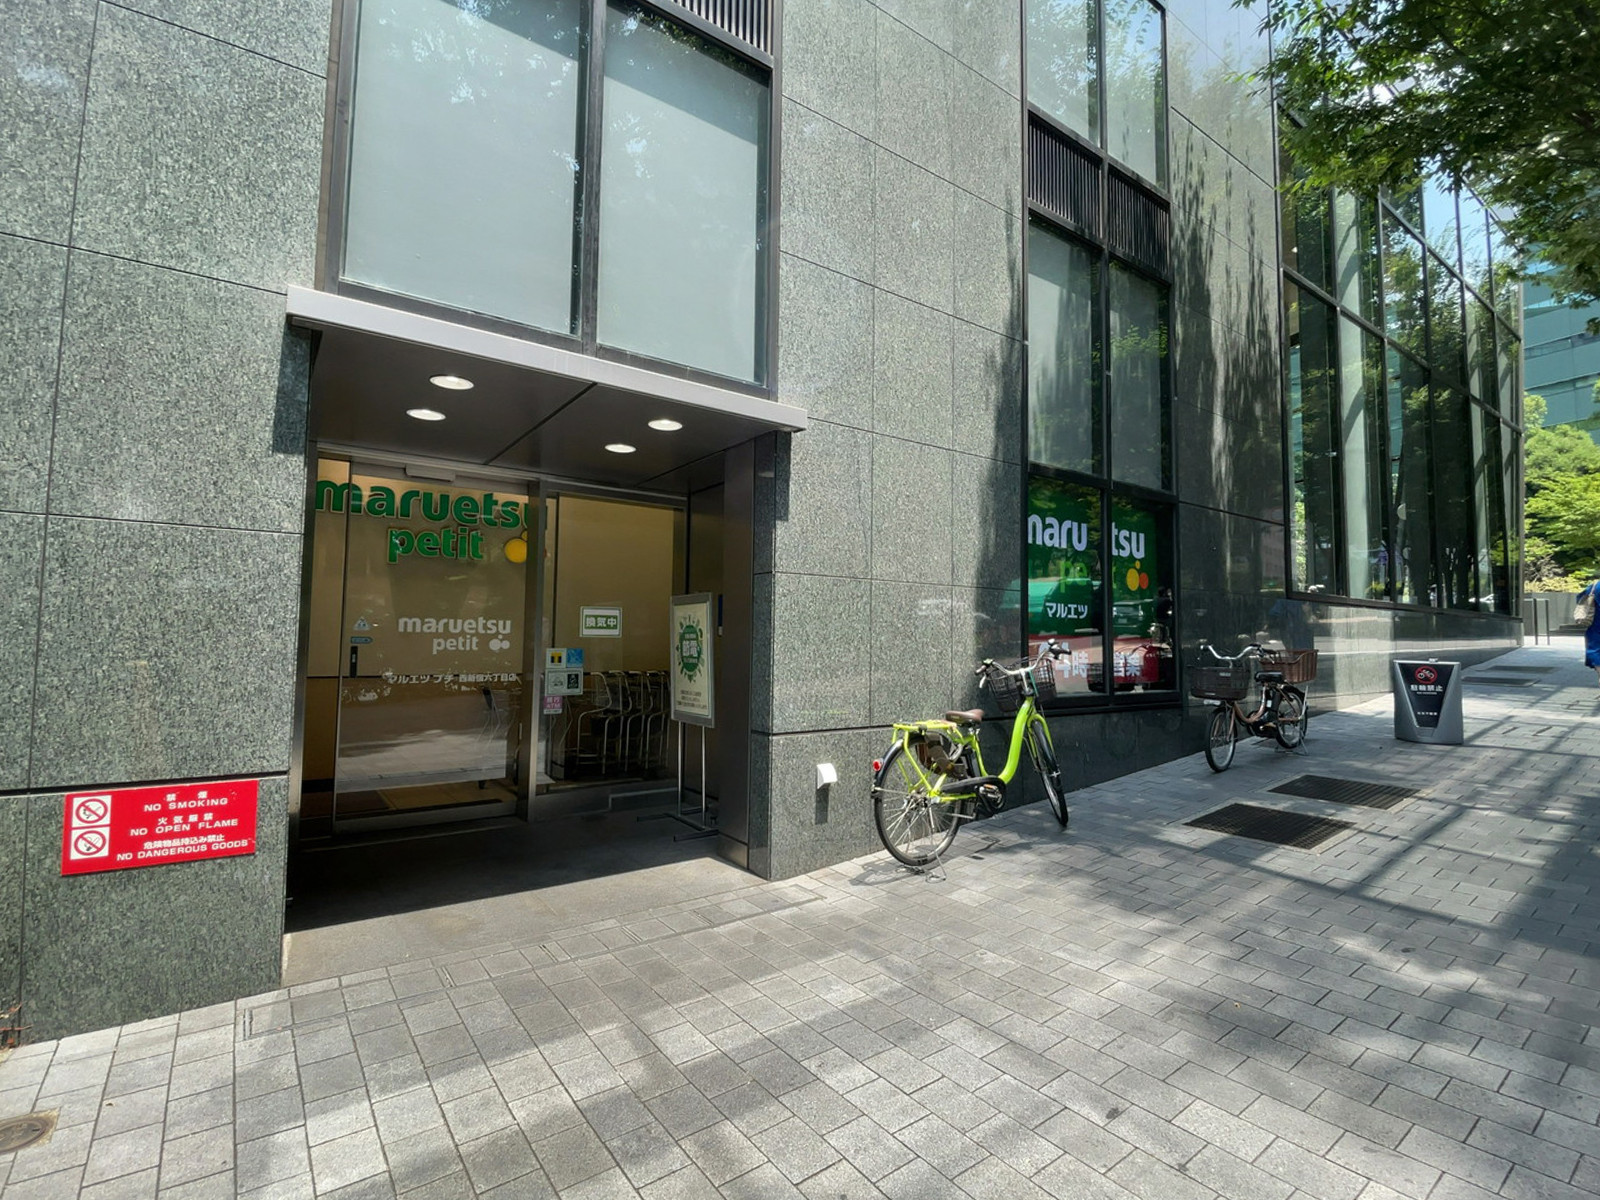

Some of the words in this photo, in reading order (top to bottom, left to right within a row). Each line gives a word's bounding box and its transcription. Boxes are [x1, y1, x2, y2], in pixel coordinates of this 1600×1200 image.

[315, 480, 530, 529] maruets
[387, 527, 484, 563] petit
[1028, 513, 1145, 559] marutsu
[1045, 602, 1088, 619] マルエツ
[398, 616, 512, 634] maruetsu
[432, 635, 479, 655] petit
[144, 803, 162, 812] NO
[168, 797, 228, 810] SMOKING
[130, 828, 148, 837] NO
[155, 823, 191, 834] OPEN
[198, 818, 238, 830] FLAME
[116, 852, 133, 861] NO
[137, 844, 208, 859] DANGEROUS
[211, 839, 248, 851] GOODS
